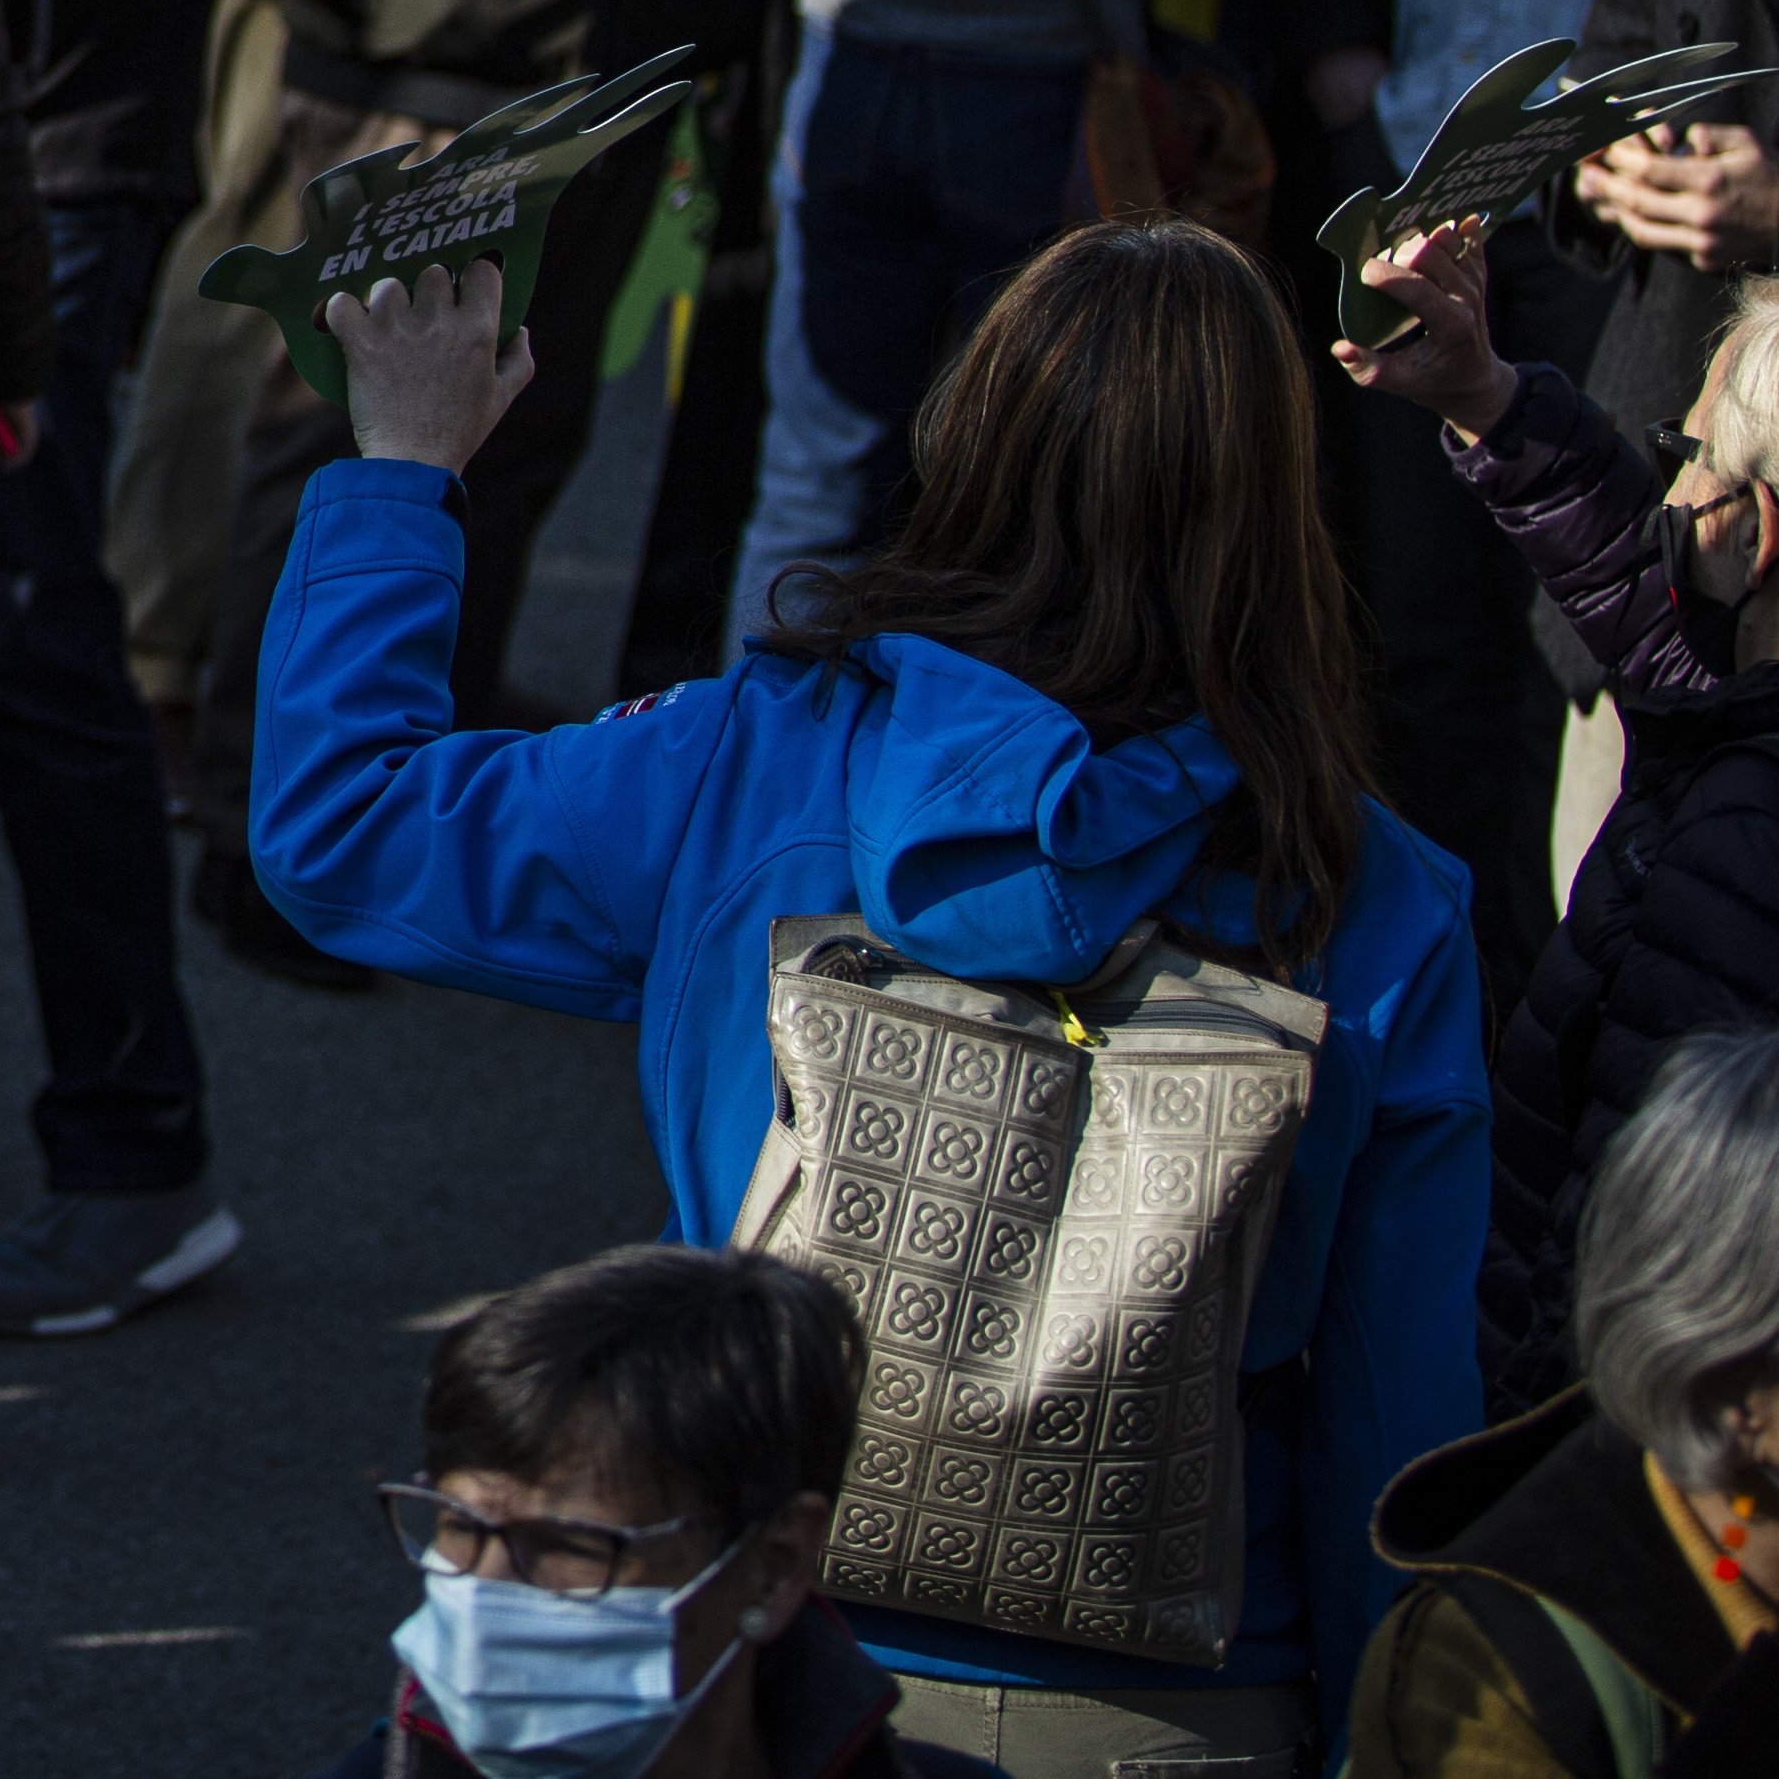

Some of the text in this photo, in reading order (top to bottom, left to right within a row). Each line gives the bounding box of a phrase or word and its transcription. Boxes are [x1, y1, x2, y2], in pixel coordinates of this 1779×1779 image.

[427, 146, 511, 183] ARA
[352, 202, 374, 222] I
[317, 198, 517, 283] EN CATALÀ
